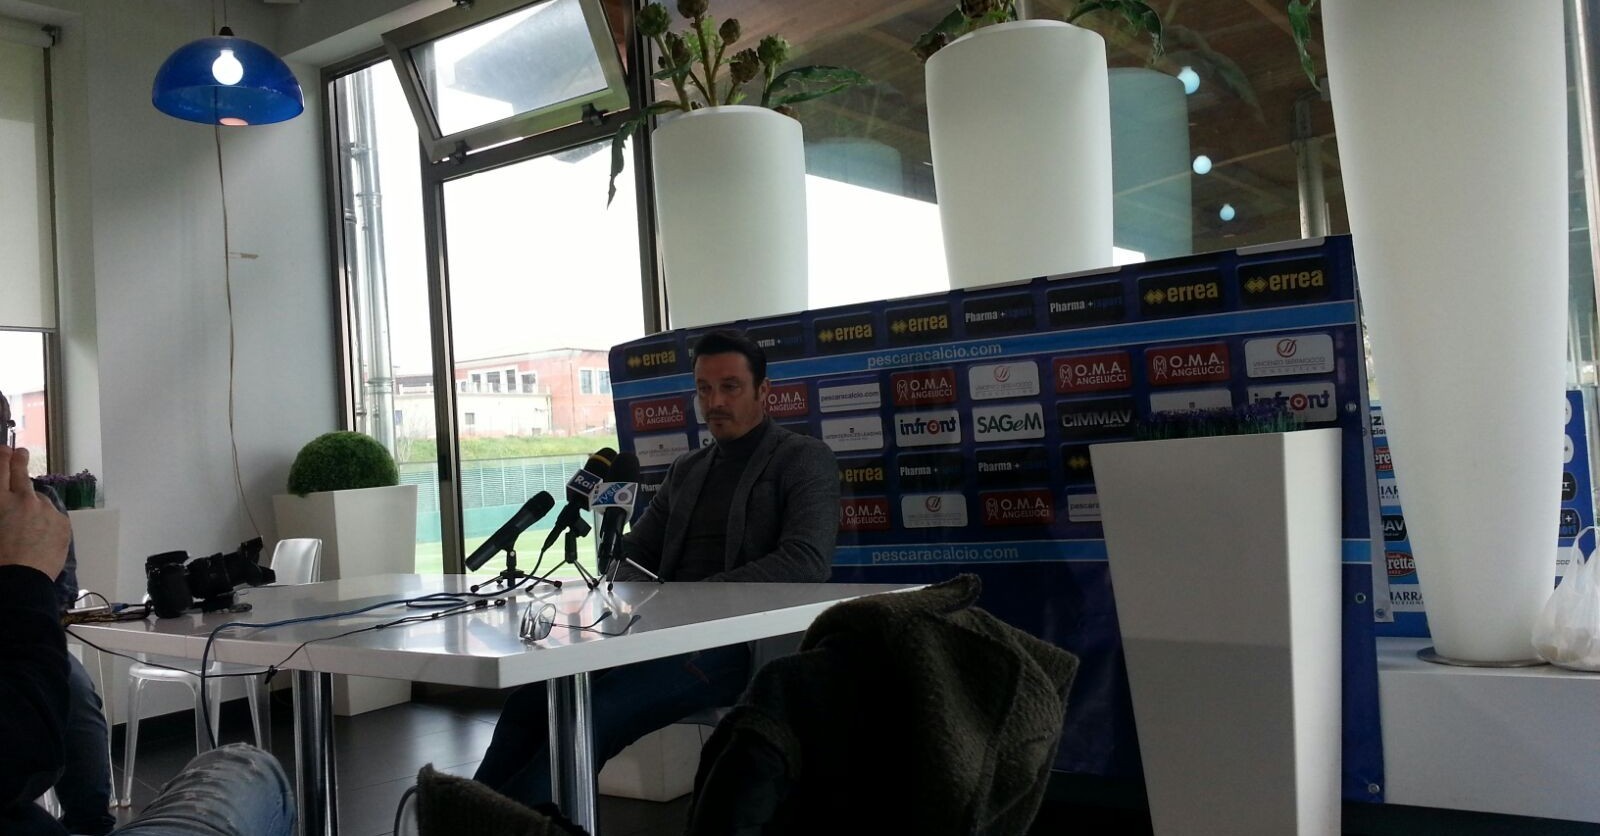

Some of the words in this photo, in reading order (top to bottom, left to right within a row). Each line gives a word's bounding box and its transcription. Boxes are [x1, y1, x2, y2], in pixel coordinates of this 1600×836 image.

[1269, 269, 1324, 291] errea
[1167, 281, 1218, 302] errea
[1049, 299, 1085, 313] Pharma
[908, 314, 948, 332] errea
[965, 311, 998, 322] Pharma
[835, 323, 872, 341] errea
[642, 349, 676, 366] errea
[867, 342, 1002, 369] pescaracalcio.com
[1169, 352, 1224, 368] O.M.A.
[1075, 361, 1126, 376] O.M.A.
[1171, 364, 1225, 377] ANGELUCCI
[910, 376, 952, 391] O.M.A.
[1076, 374, 1127, 385] ANGELUCCI
[768, 392, 805, 404] O.M.A.
[911, 388, 952, 399] ANGELUCCI
[645, 407, 683, 418] O.M.A.
[769, 402, 805, 412] ANGELUCCI
[646, 415, 684, 425] ANGELUCCI
[1062, 409, 1132, 427] CIMMAV
[900, 417, 956, 435] infront
[900, 466, 931, 476] Pharma
[978, 461, 1012, 473] Pharma
[845, 466, 884, 483] errea
[574, 475, 596, 490] Rai
[641, 483, 662, 492] Pharm
[845, 504, 887, 516] O.M.A.
[1001, 497, 1049, 510] O.M.A.
[1002, 508, 1049, 519] ANGELUCCI
[846, 515, 887, 526] ANGELUCCI
[872, 545, 1019, 564] pescaracalcio.com
[1388, 557, 1416, 570] retta
